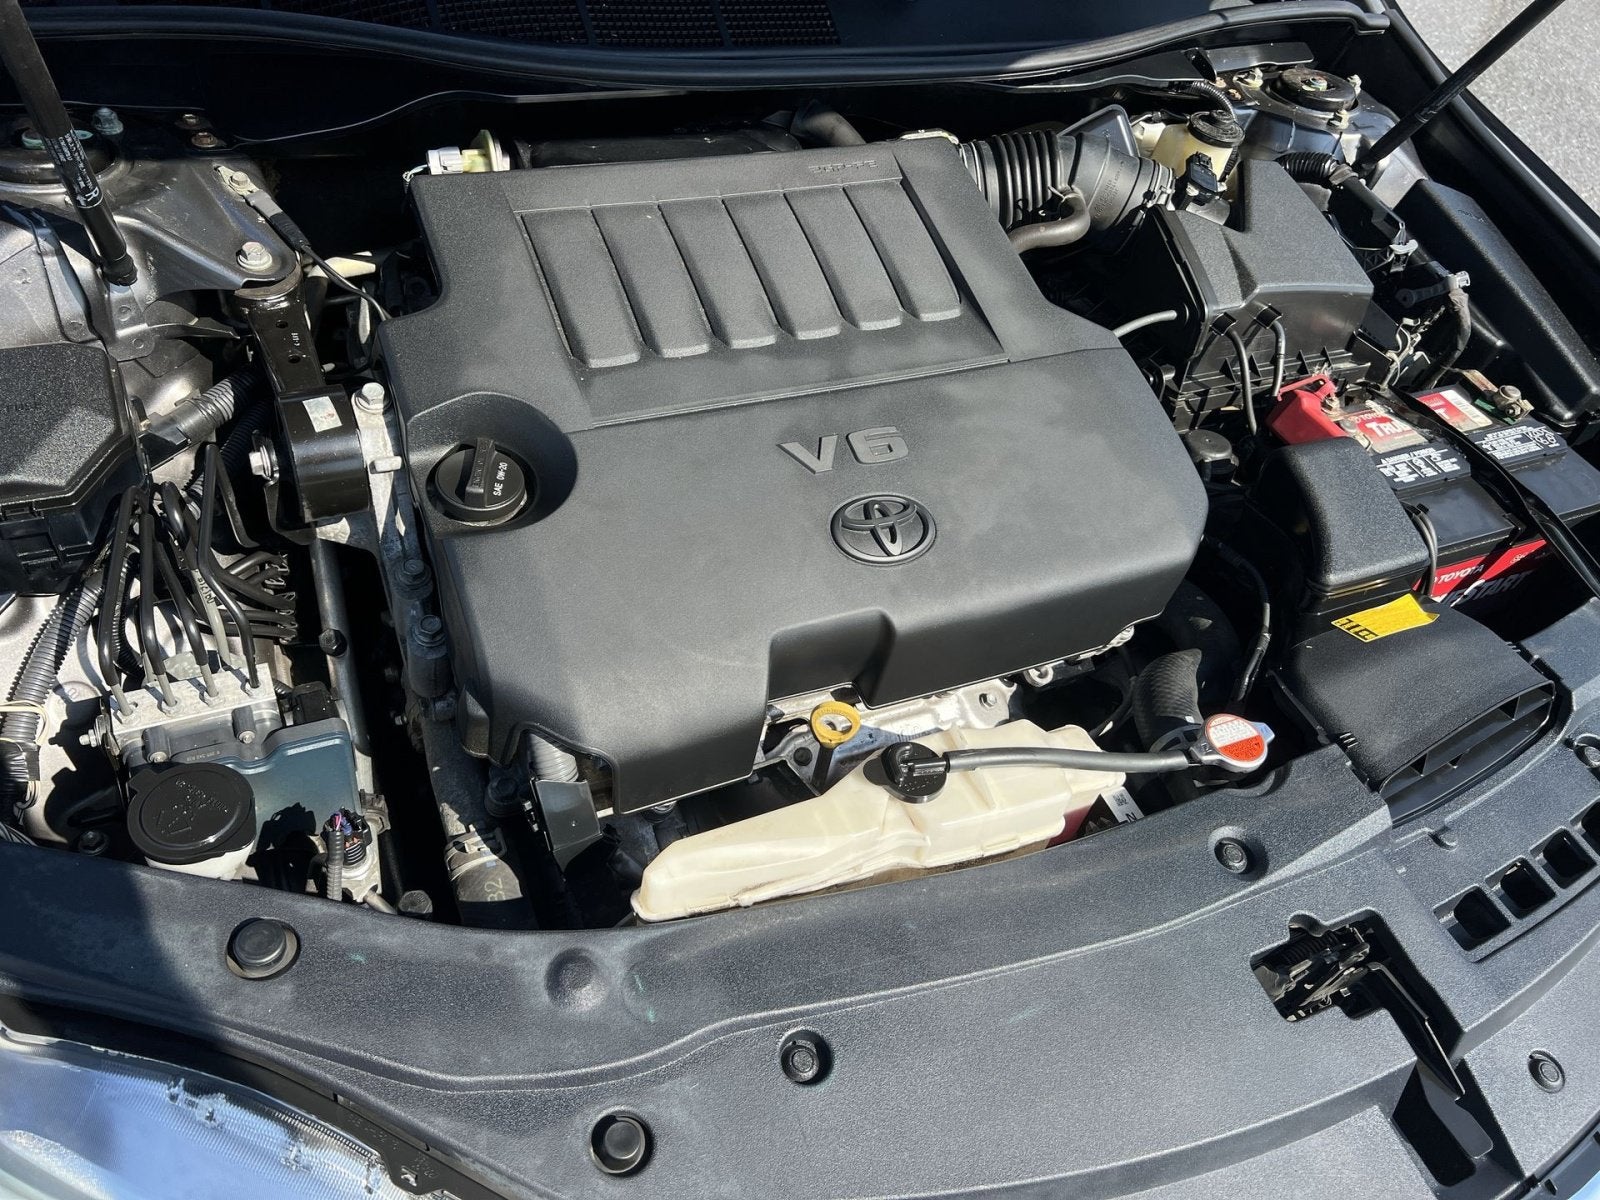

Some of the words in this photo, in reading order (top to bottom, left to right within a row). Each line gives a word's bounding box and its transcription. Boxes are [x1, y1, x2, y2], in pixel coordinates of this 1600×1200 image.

[776, 425, 909, 475] V6
[496, 461, 508, 480] 0W-20
[493, 482, 503, 496] SAE
[1438, 564, 1485, 585] TOYOTA
